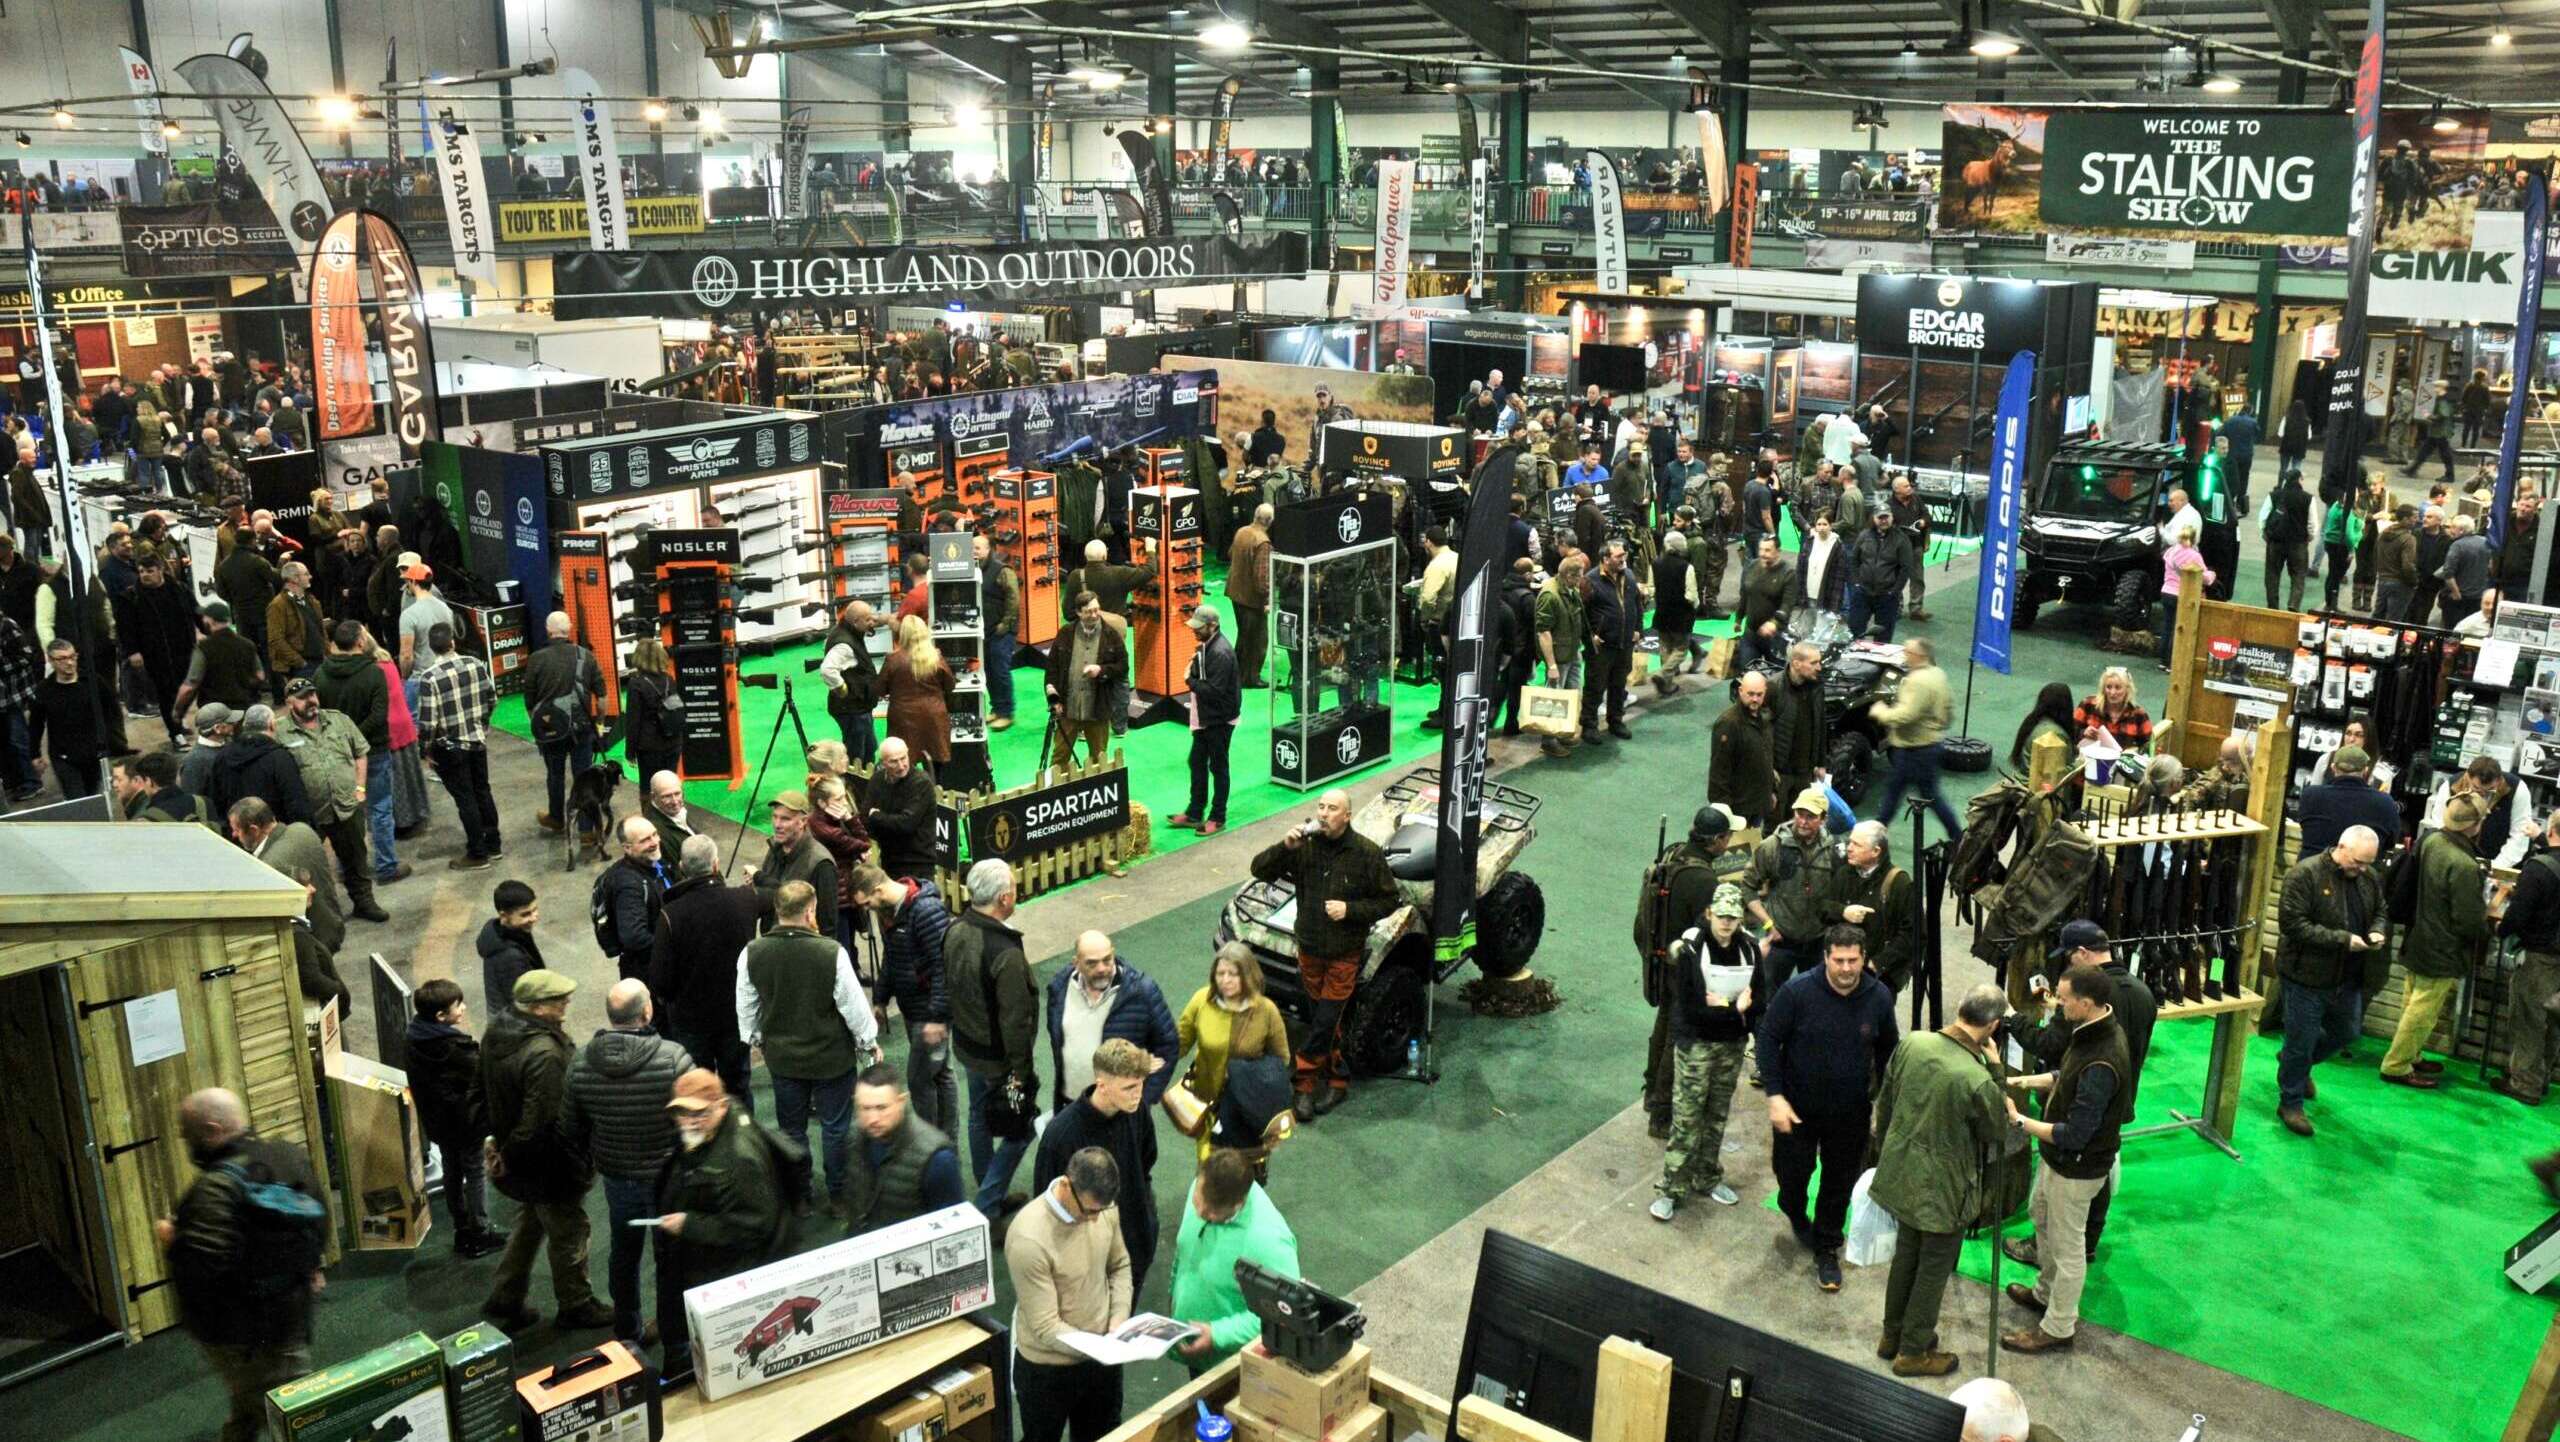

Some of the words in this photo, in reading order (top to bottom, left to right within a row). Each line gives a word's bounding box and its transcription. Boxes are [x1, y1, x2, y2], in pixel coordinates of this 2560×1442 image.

[2144, 119, 2229, 135] WELCOME
[2236, 119, 2260, 135] TO
[227, 98, 299, 191] HAWKE
[2170, 139, 2221, 154] THE
[2079, 151, 2315, 201] STALKING
[592, 163, 616, 250] TARGET
[1864, 208, 1891, 222] APRIL
[1892, 208, 1918, 222] 2023
[2128, 196, 2253, 226] SHOW
[452, 170, 482, 264] TARGETS
[505, 208, 556, 233] YOU'RE
[560, 207, 574, 230] IN
[641, 202, 699, 228] COUNTRY
[246, 231, 286, 241] ACCURA
[1376, 174, 1402, 302] Woolpower
[751, 253, 990, 299] HIGHLAND
[999, 244, 1195, 289] OUTDOORS
[2370, 251, 2517, 285] GMK
[71, 286, 125, 303] Office
[1909, 308, 1985, 333] EDGAR
[2101, 308, 2168, 329] LANX
[1464, 328, 1528, 342] edgarbrothers.com
[1908, 329, 1985, 349] BROTHERS
[2374, 350, 2386, 380] TIKKA
[1176, 390, 1198, 402] DIAN
[1023, 418, 1056, 432] HARDY
[667, 456, 741, 476] CHRISTENSEN
[911, 451, 936, 467] MDT
[1353, 454, 1392, 468] ROVINCE
[1432, 457, 1461, 470] ROVINCE
[690, 469, 720, 481] ARMS
[270, 503, 317, 521] ARMIN
[1990, 416, 2018, 621] POLARIS
[469, 516, 503, 531] HIGHLAND
[1137, 515, 1158, 529] GPO
[1176, 515, 1197, 530] GPO
[470, 524, 504, 541] OUTDOORS
[516, 539, 540, 551] EUROPE
[562, 538, 598, 549] PROOF
[661, 541, 728, 553] NOSLER
[493, 636, 524, 651] DRAW
[2213, 640, 2232, 654] WIN
[2238, 646, 2276, 661] stalking
[2236, 655, 2288, 671] experience
[1025, 781, 1120, 827] SPARTAN
[1026, 818, 1071, 841] PRECISION
[1072, 804, 1120, 829] EQUIPMENT
